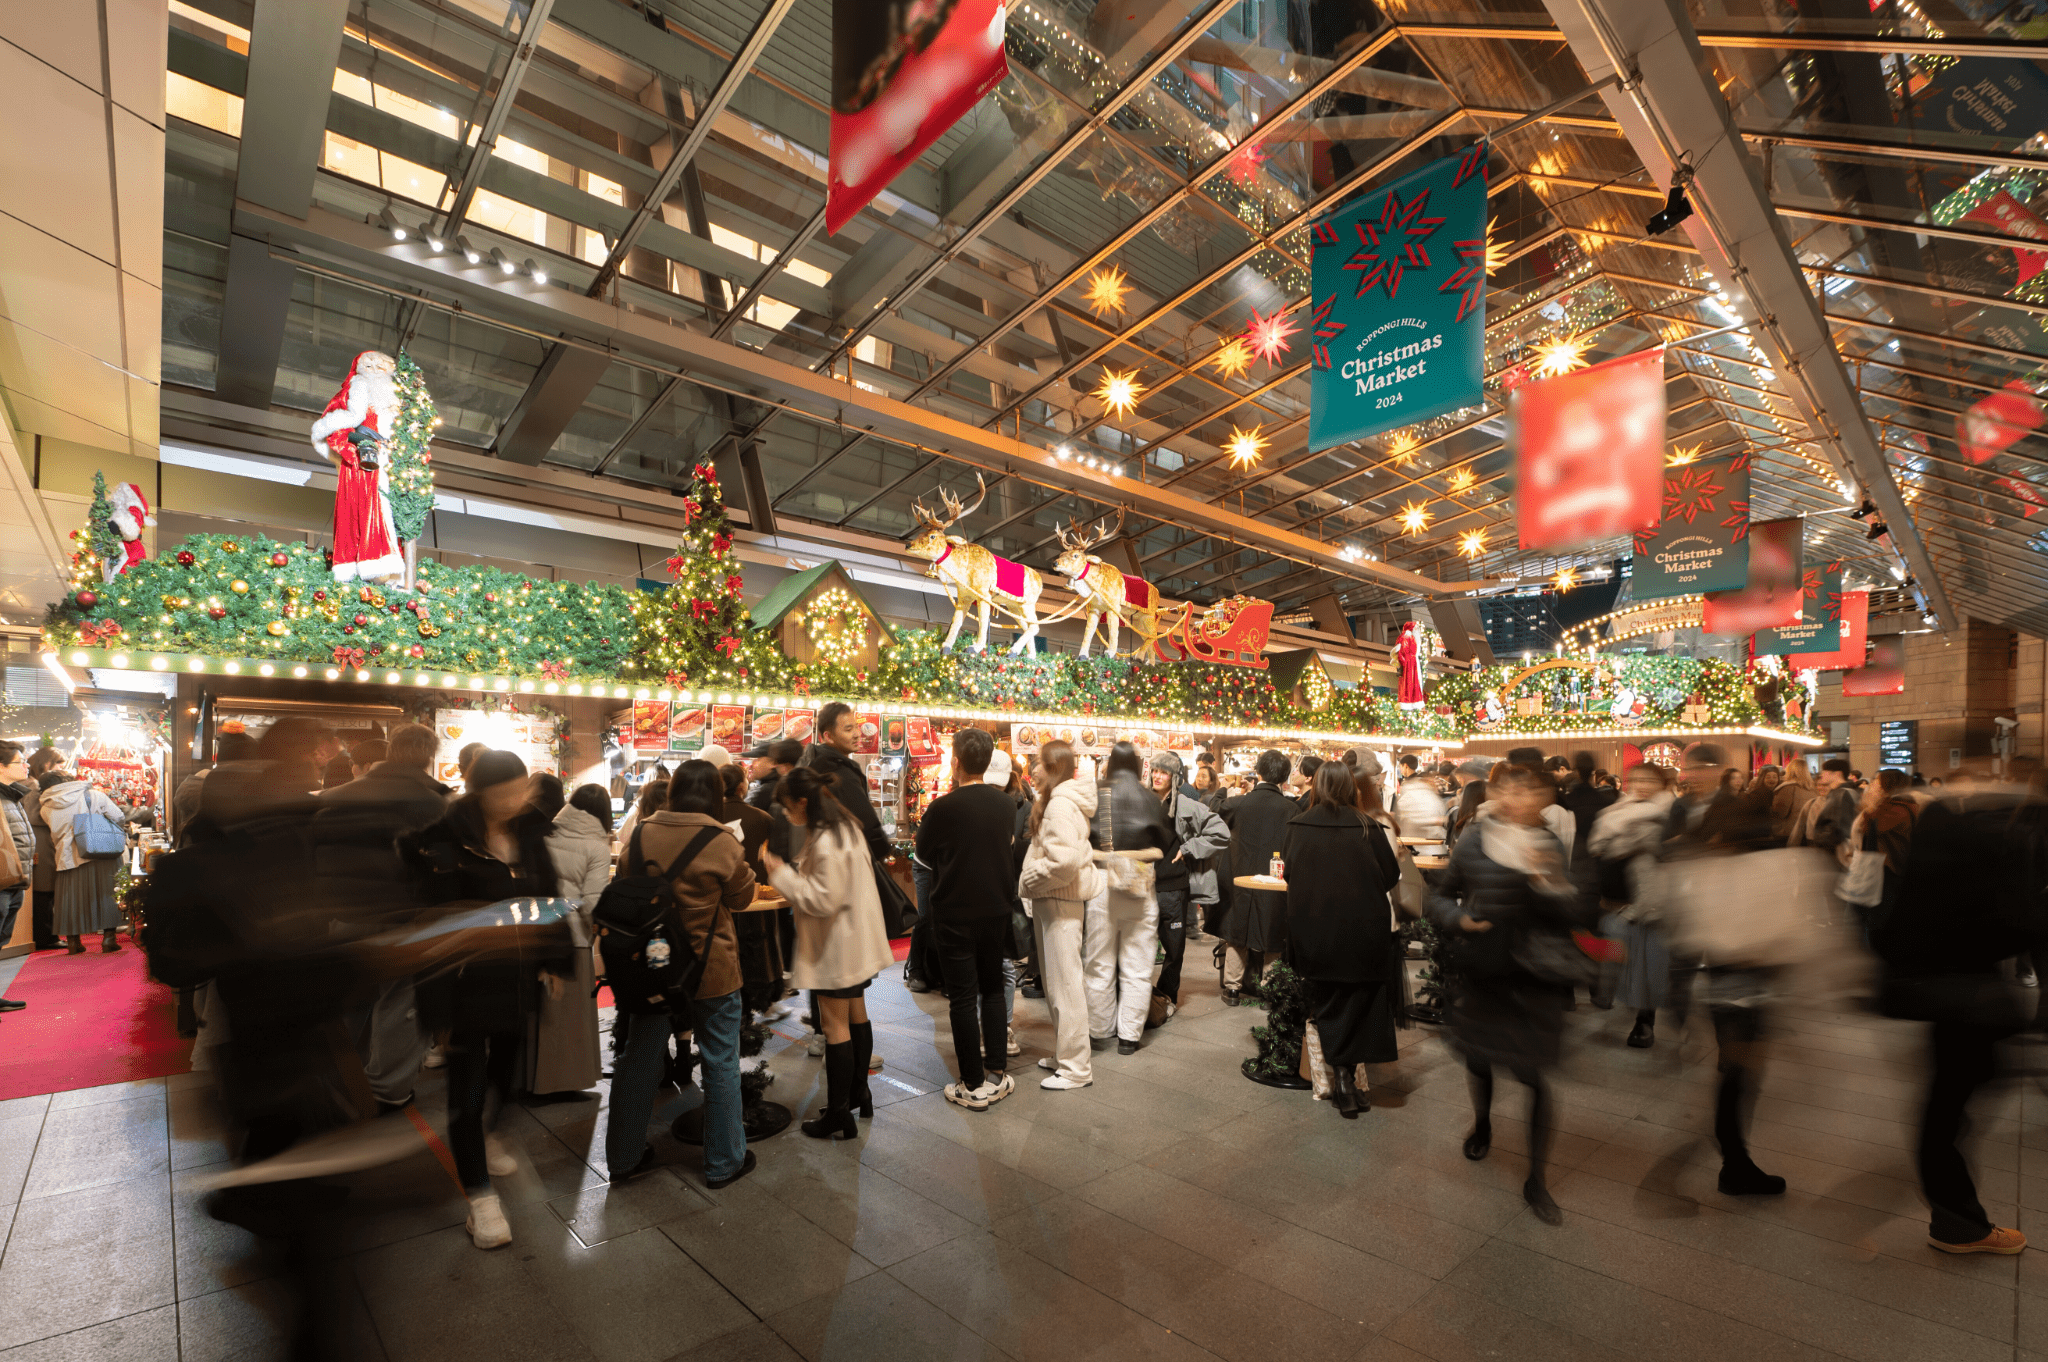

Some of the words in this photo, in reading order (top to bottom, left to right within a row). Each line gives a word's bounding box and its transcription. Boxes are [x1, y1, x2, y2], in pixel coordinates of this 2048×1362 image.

[1356, 319, 1401, 352] ROPPONGI
[1401, 317, 1428, 329] HILLS
[1341, 334, 1443, 379] Christmas
[1355, 359, 1427, 397] Market
[1375, 392, 1403, 409] 2024
[1655, 547, 1723, 563] Christmas
[1664, 559, 1713, 574] Market
[1678, 574, 1697, 583] 2024
[1630, 614, 1679, 629] Christmas
[1681, 612, 1702, 620] Mar
[1780, 631, 1816, 640] Market
